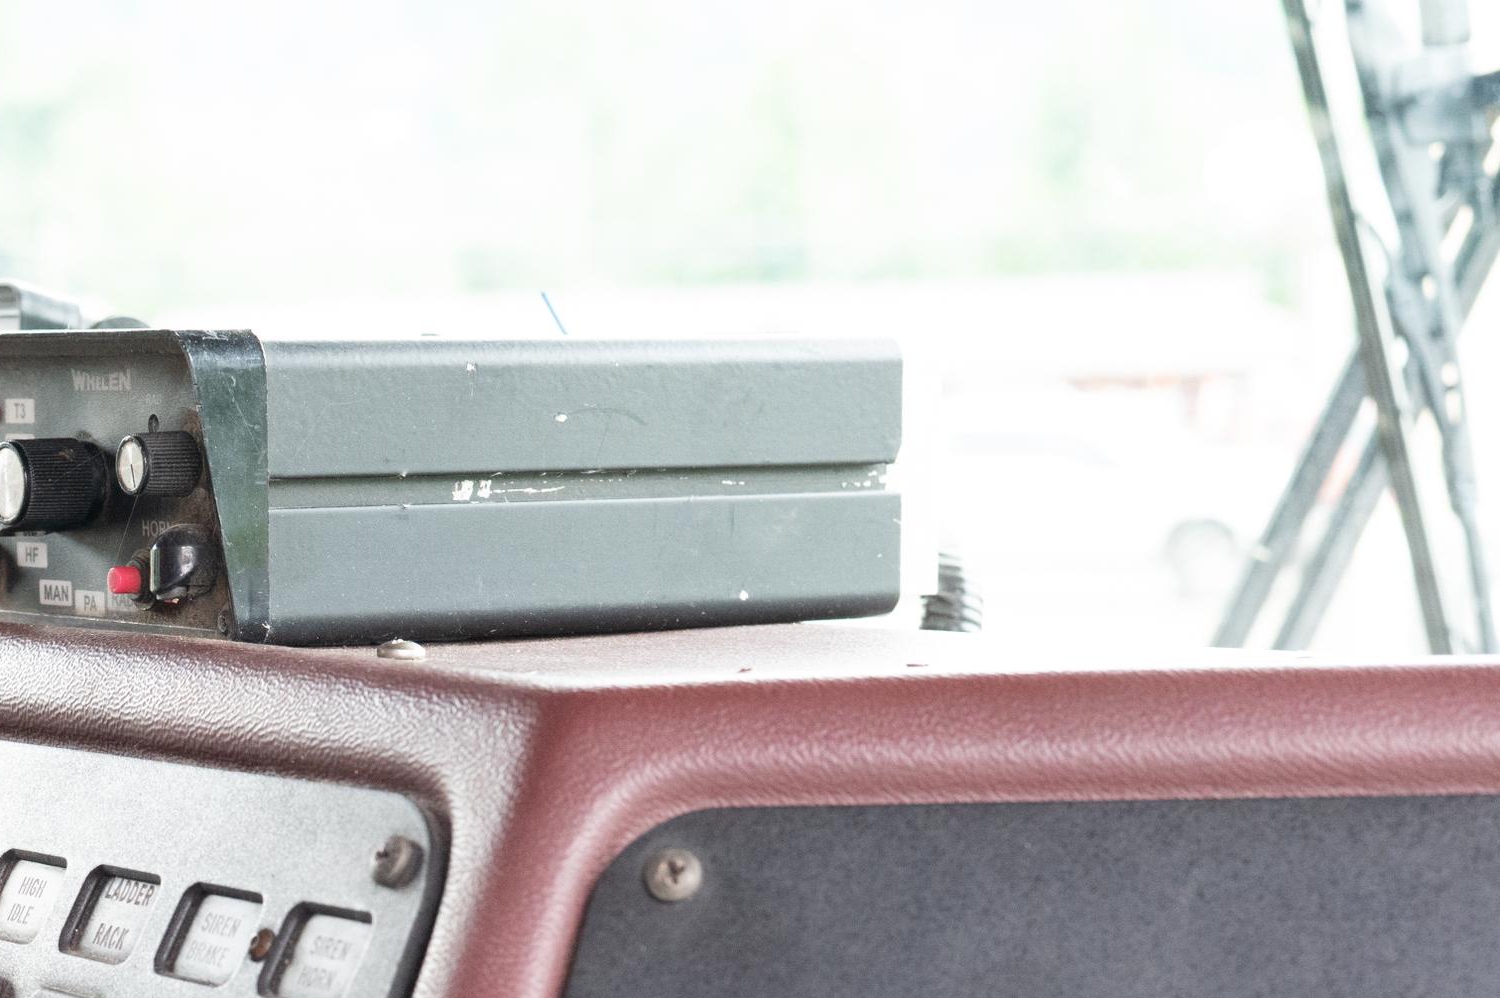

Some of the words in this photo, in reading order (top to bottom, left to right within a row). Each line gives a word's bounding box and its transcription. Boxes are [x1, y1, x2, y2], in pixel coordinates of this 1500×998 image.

[13, 402, 26, 419] T3
[25, 546, 39, 563] HF
[43, 584, 69, 602] MAN
[84, 595, 98, 612] PA
[17, 875, 47, 900] HIGH
[104, 875, 156, 908] LADDER
[7, 903, 35, 926] IDLE
[200, 911, 242, 938] SIREN
[91, 922, 131, 952] RACK
[309, 934, 352, 962] SIREN
[185, 939, 231, 969] BRAKE
